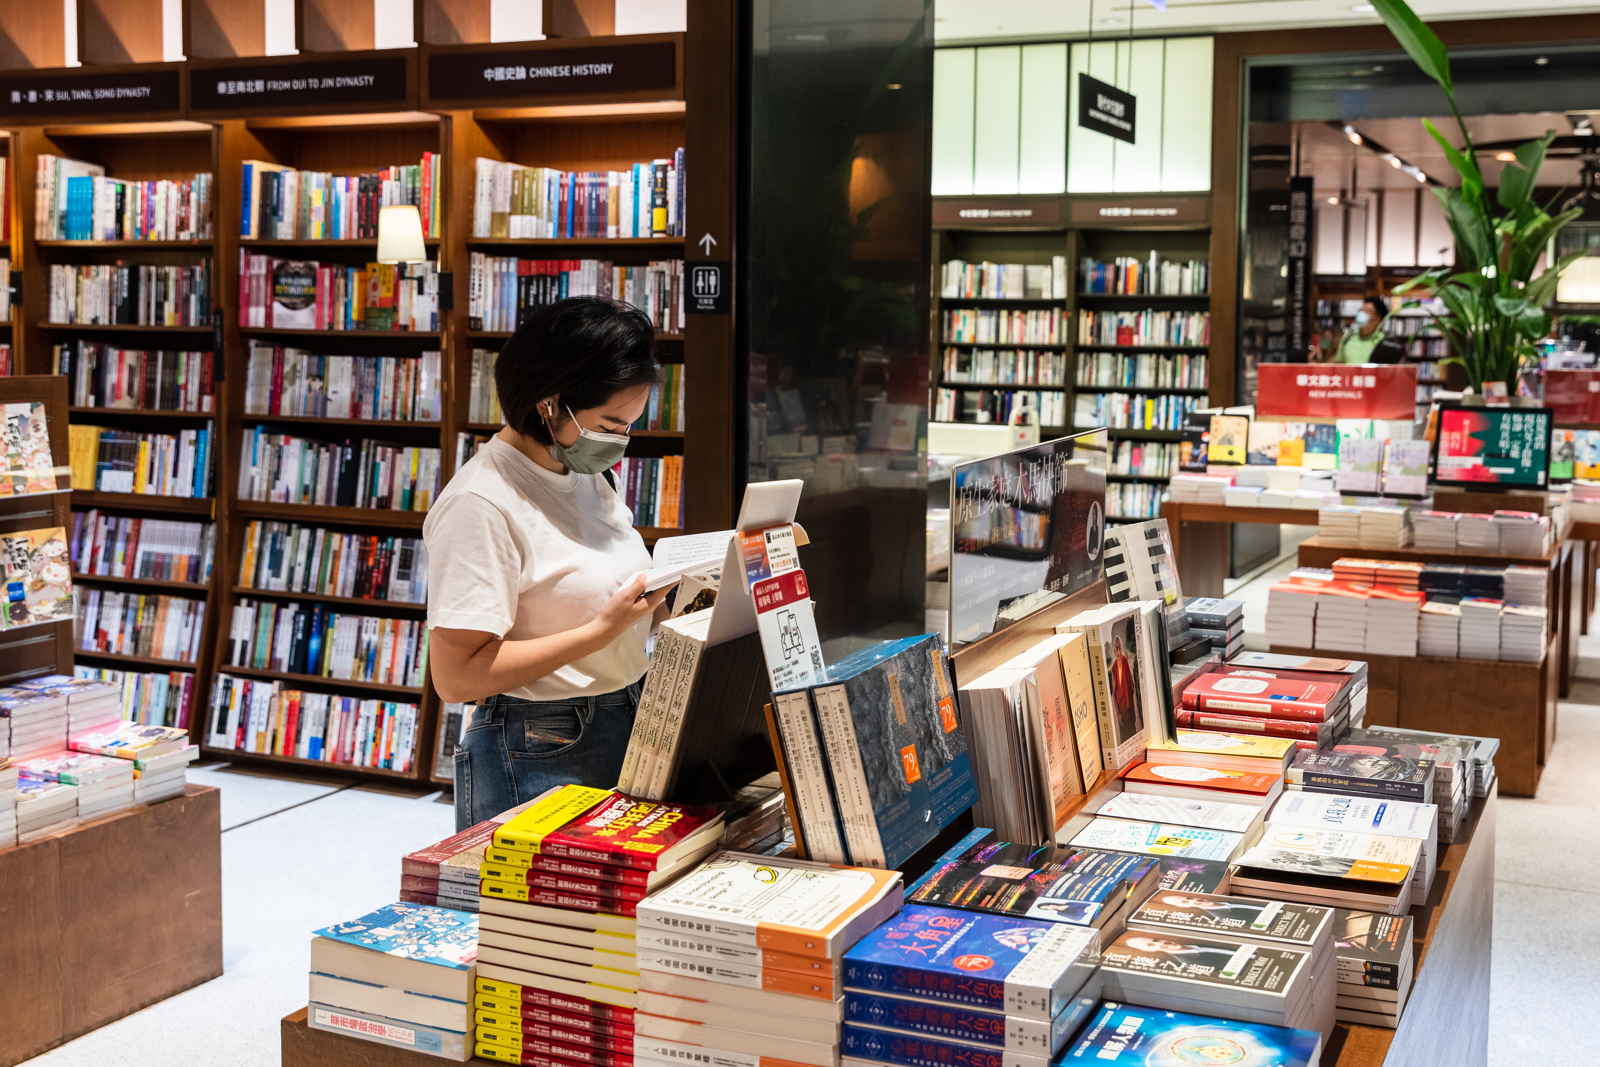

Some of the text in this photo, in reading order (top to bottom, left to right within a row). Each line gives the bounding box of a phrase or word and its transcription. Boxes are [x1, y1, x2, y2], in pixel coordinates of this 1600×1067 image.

[529, 65, 571, 78] CHINESE
[572, 63, 614, 75] HISTORY
[267, 80, 291, 91] FROM
[308, 78, 319, 89] TO
[335, 75, 374, 88] DYNASTY
[117, 86, 151, 98] DYNASTY
[1308, 390, 1326, 398] NEW
[630, 812, 683, 838] CHINA
